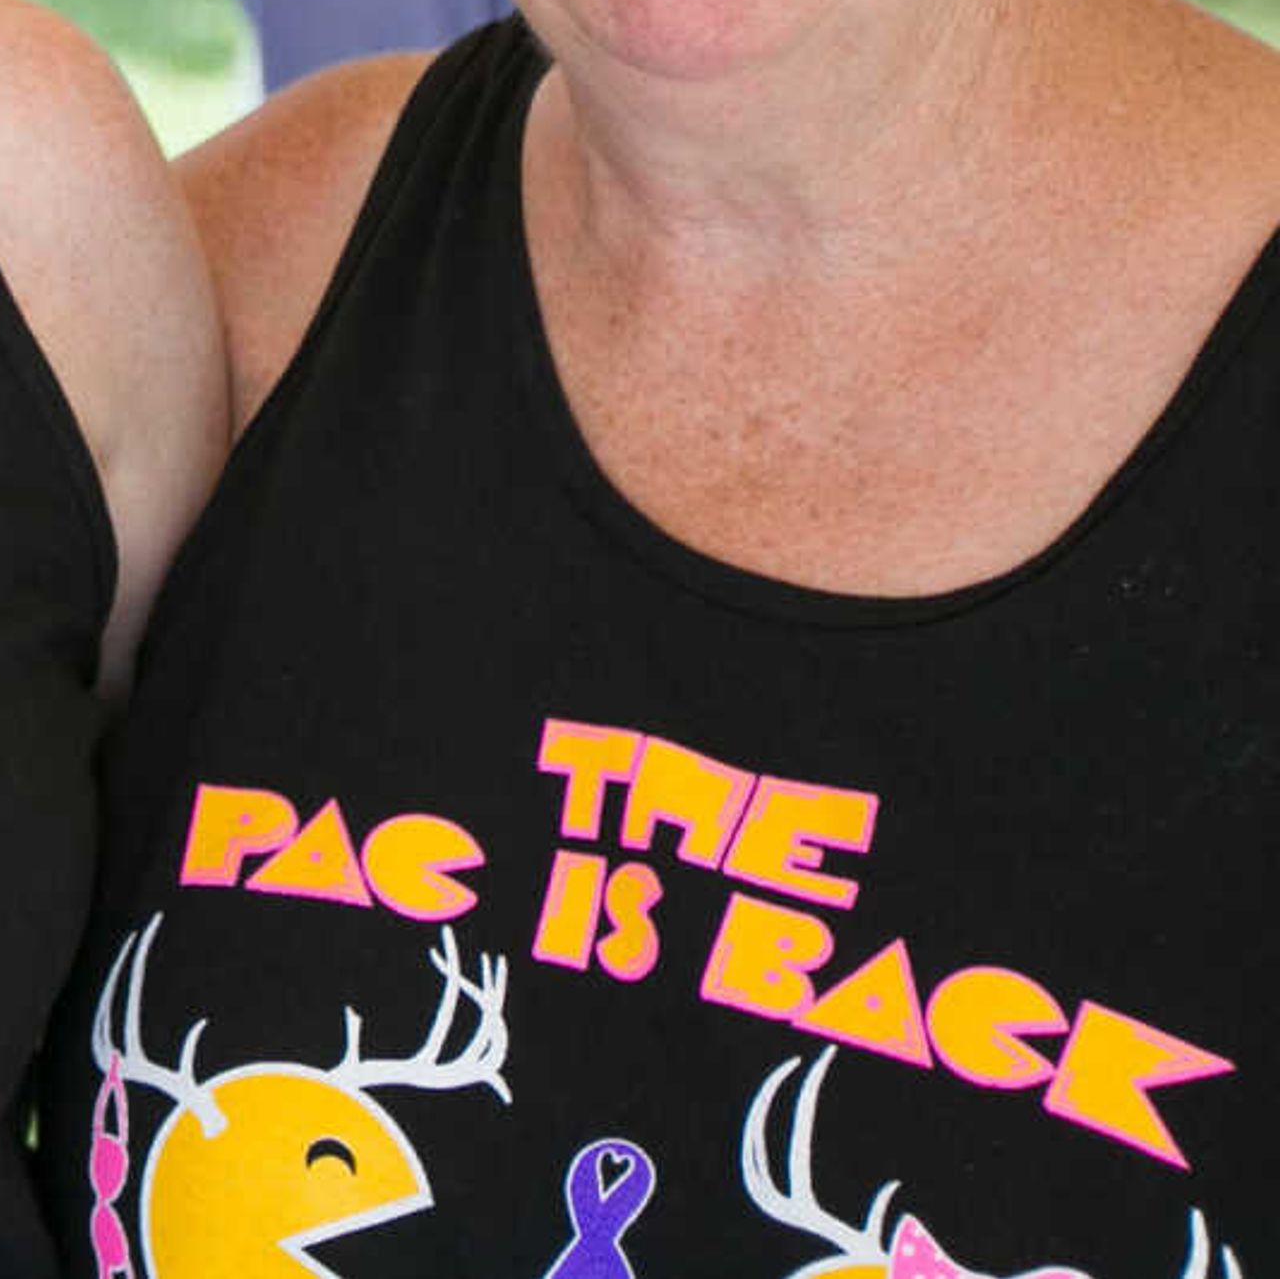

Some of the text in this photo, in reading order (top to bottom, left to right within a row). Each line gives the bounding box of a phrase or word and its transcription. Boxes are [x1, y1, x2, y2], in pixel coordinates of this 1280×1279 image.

[536, 718, 879, 910] THE
[180, 783, 1235, 1169] PAC IS BACK
